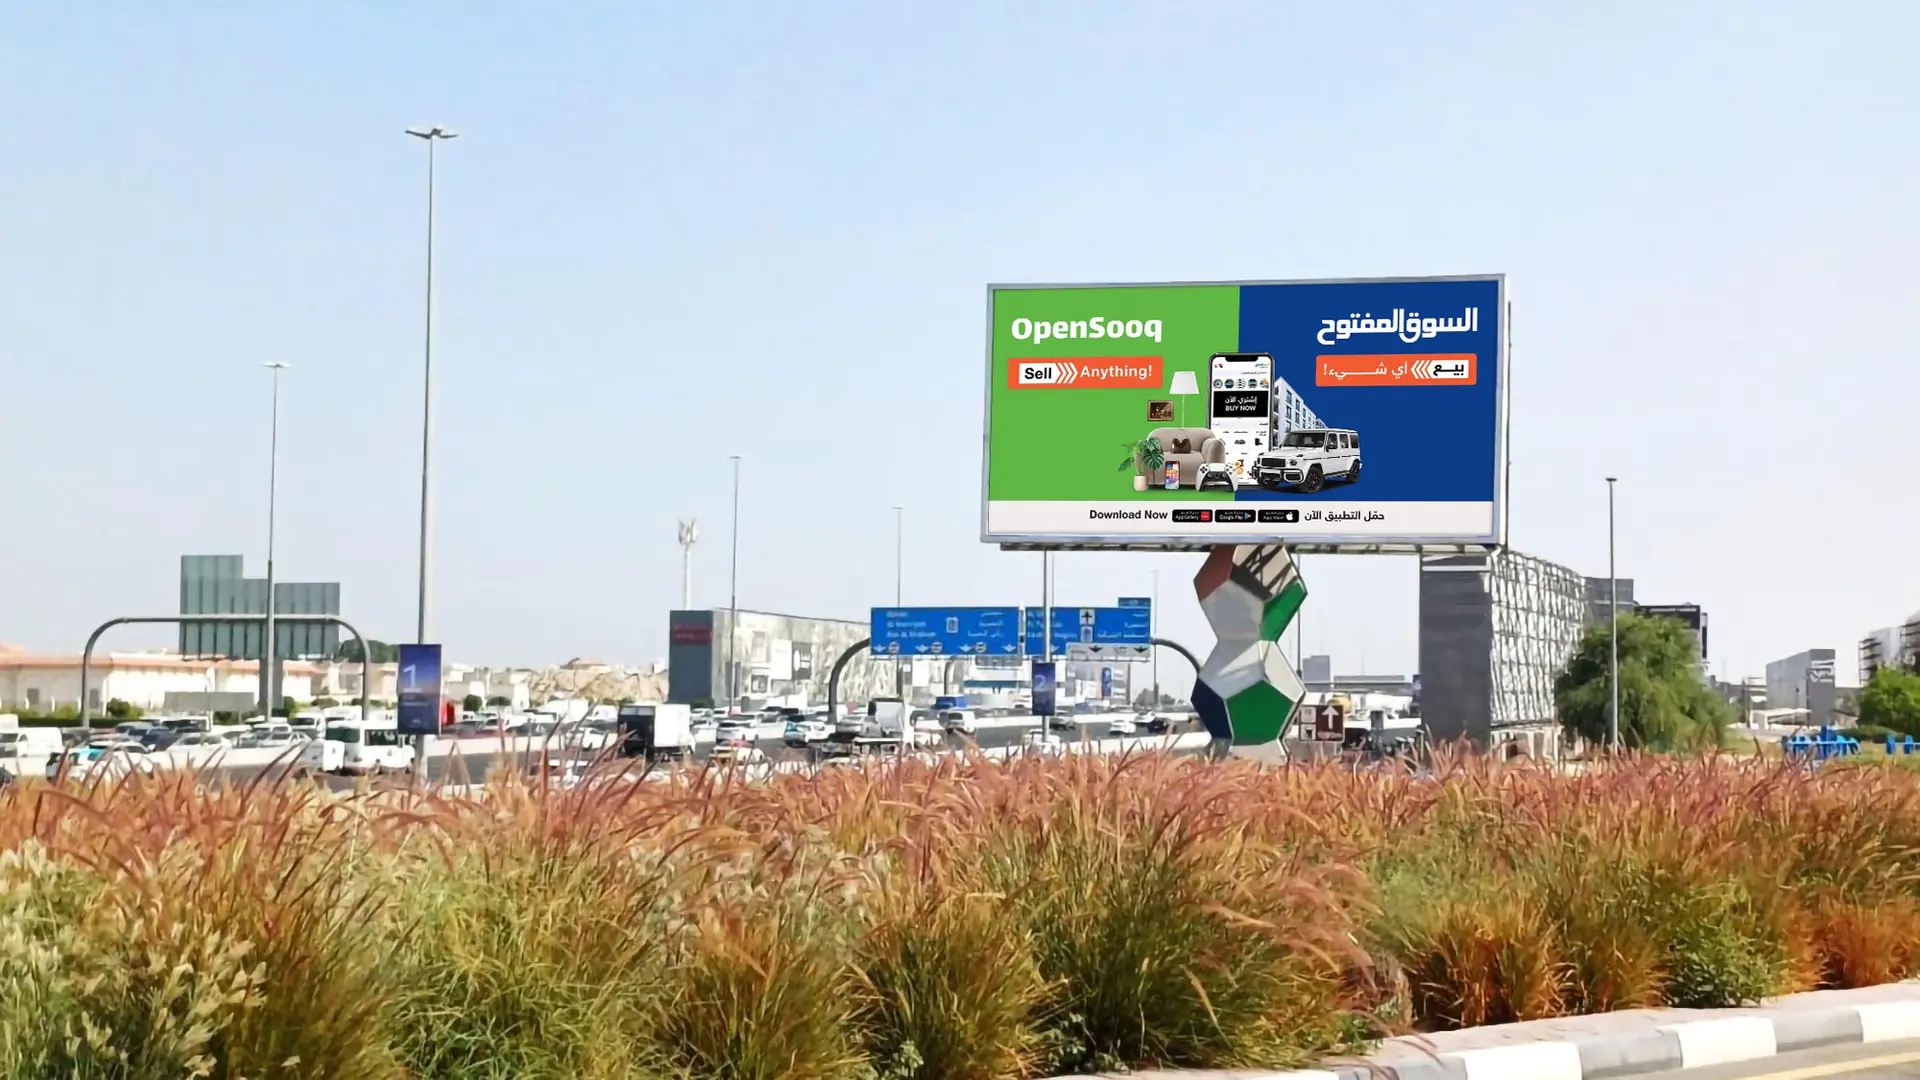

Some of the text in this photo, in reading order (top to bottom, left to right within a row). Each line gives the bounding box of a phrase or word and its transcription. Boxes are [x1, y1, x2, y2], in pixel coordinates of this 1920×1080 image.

[1011, 317, 1162, 344] OpenSooq
[1024, 365, 1152, 380] Sell Anything!
[1089, 509, 1168, 520] Download Now
[1304, 509, 1322, 521] الآن
[1324, 510, 1361, 522] التطبيق
[403, 663, 423, 693] 1
